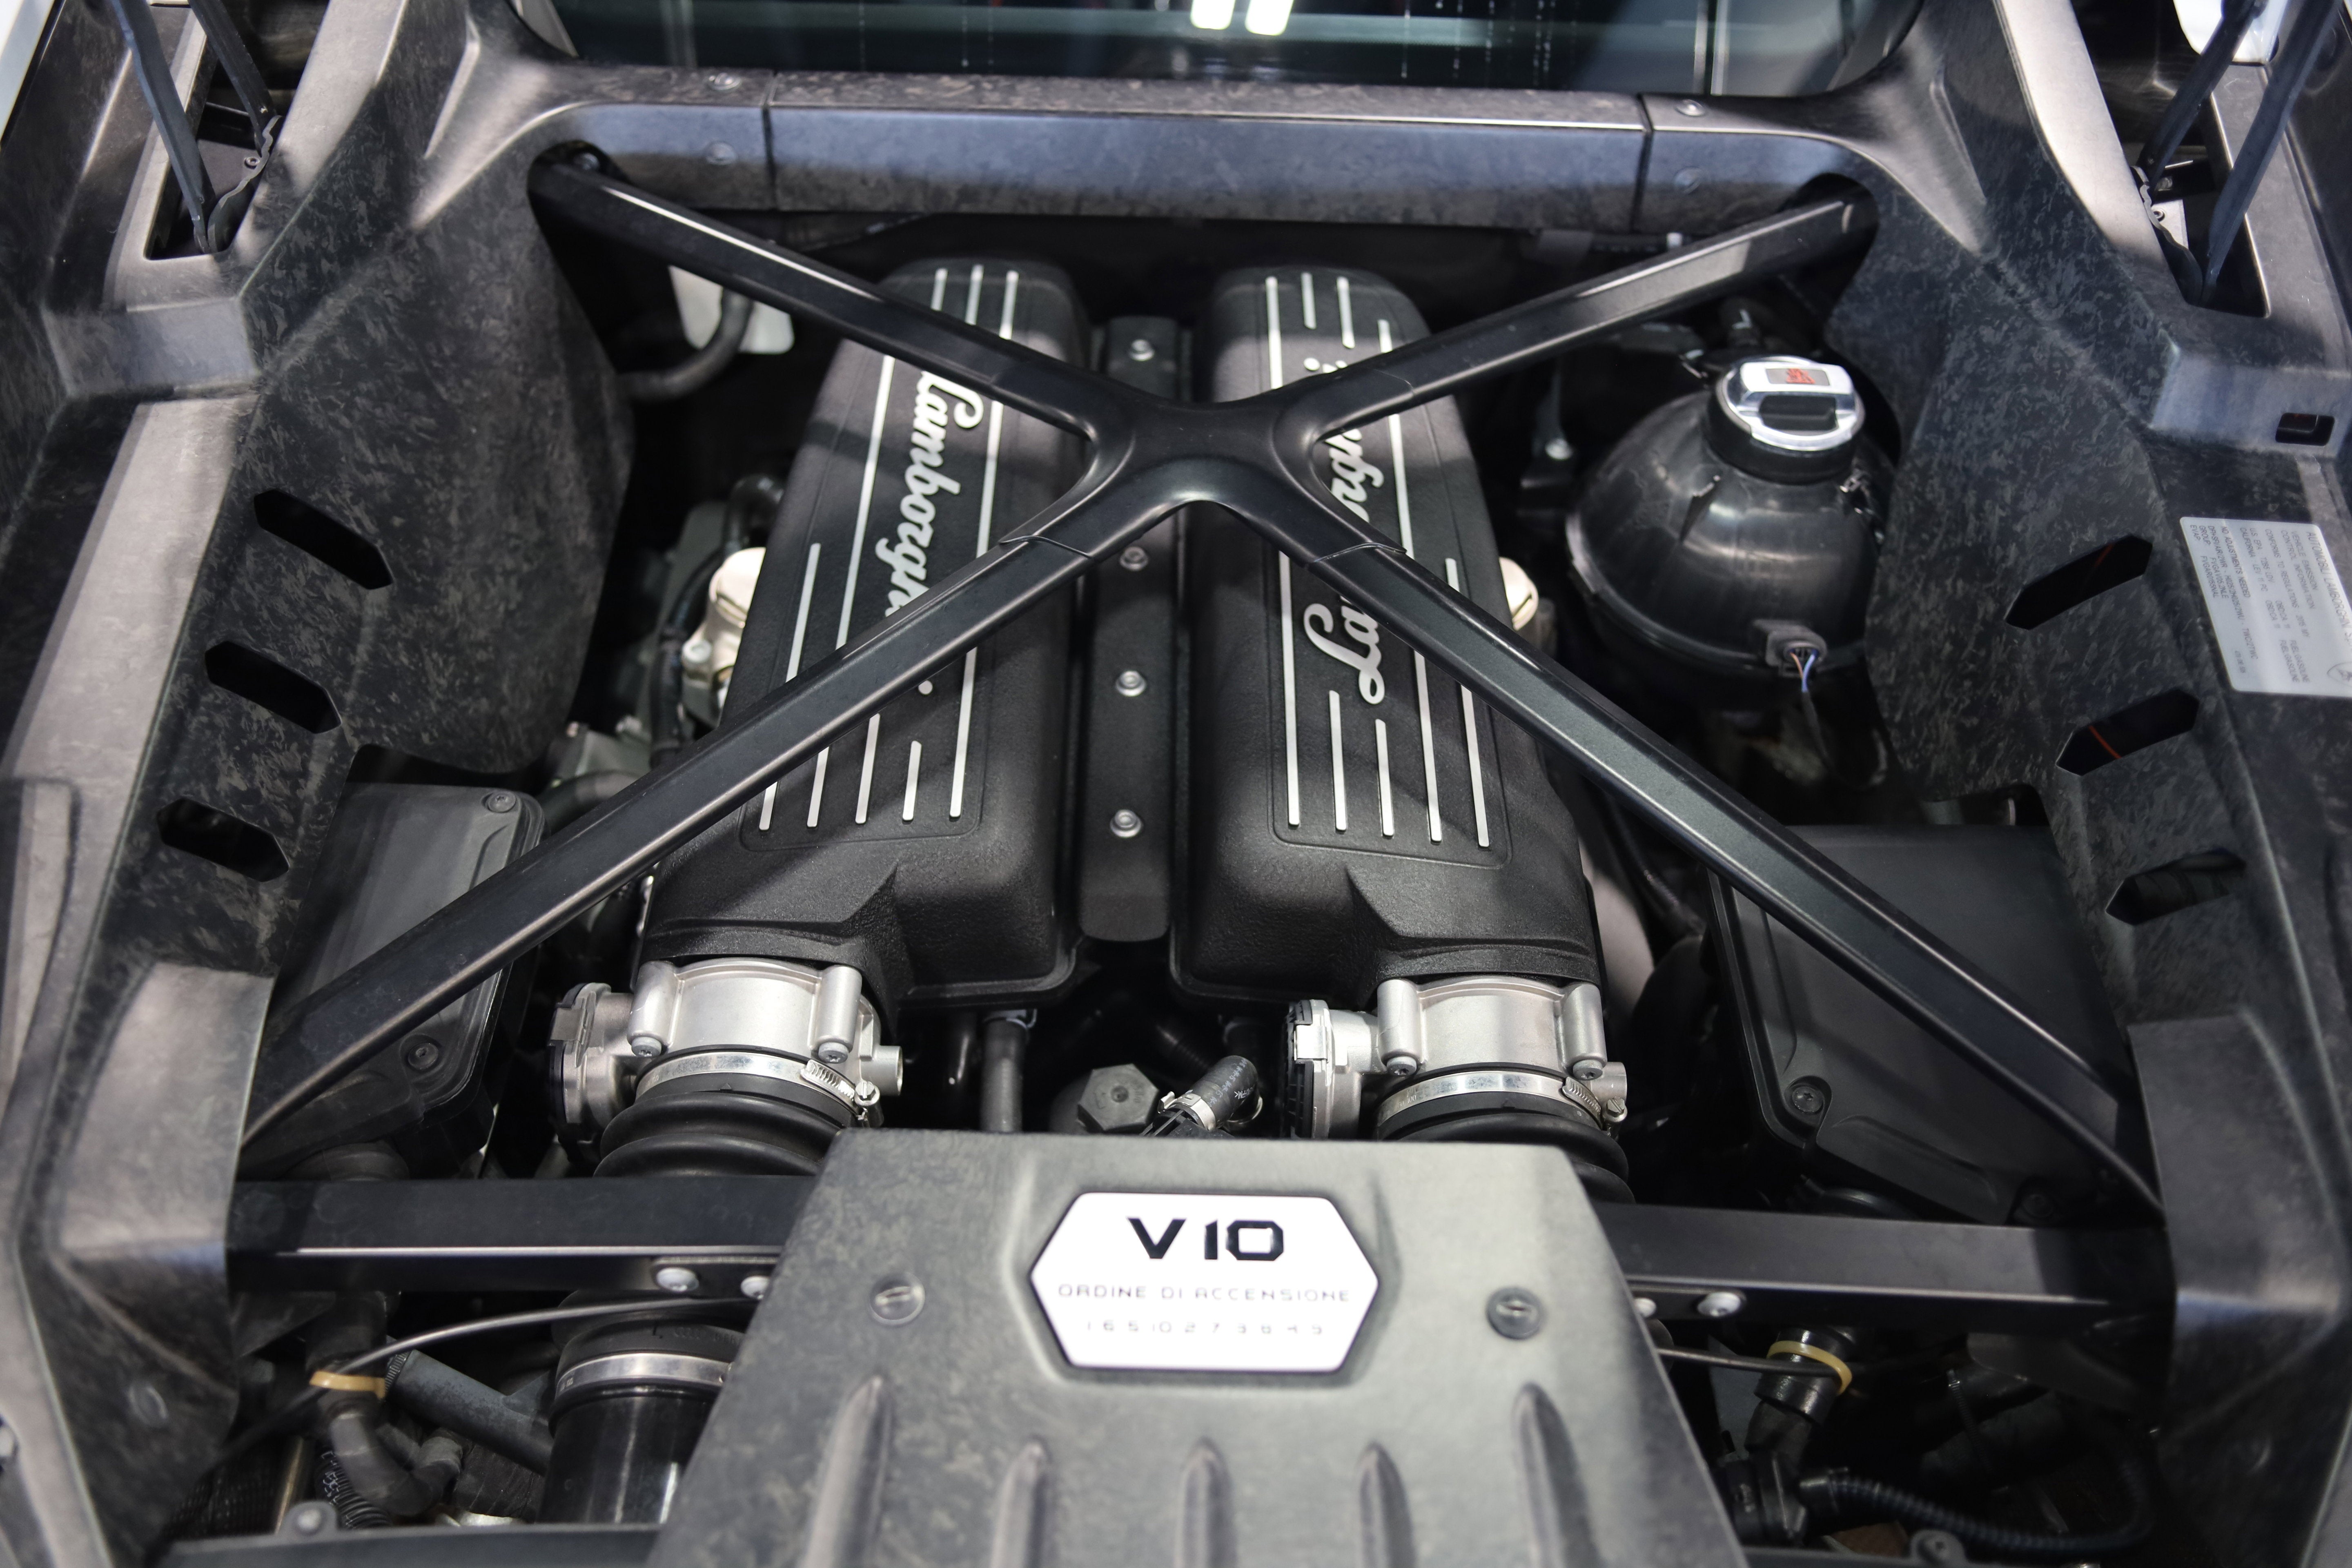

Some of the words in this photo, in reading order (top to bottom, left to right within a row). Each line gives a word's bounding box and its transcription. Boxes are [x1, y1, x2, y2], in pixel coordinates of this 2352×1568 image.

[2224, 537, 2243, 574] ADJUSTMENTS
[2238, 577, 2250, 597] NEEDED
[2240, 527, 2256, 557] CALIFORNIA
[2253, 564, 2262, 574] LEV
[2259, 584, 2268, 592] PC
[2254, 539, 2263, 550] EPA
[2265, 529, 2281, 557] CONFORMS
[2280, 571, 2299, 608] REGULATIONS
[2281, 530, 2298, 560] CONTROL
[2294, 564, 2316, 609] INFORMATION
[2291, 531, 2305, 556] VEHICLE
[2301, 560, 2318, 590] EMISSION
[2306, 532, 2331, 574] AUTOMOBILI
[1127, 1217, 1284, 1261] V10
[1058, 1284, 1146, 1298] ORDINE
[1162, 1286, 1183, 1299] DI
[1196, 1287, 1349, 1302] ACCENSIONE
